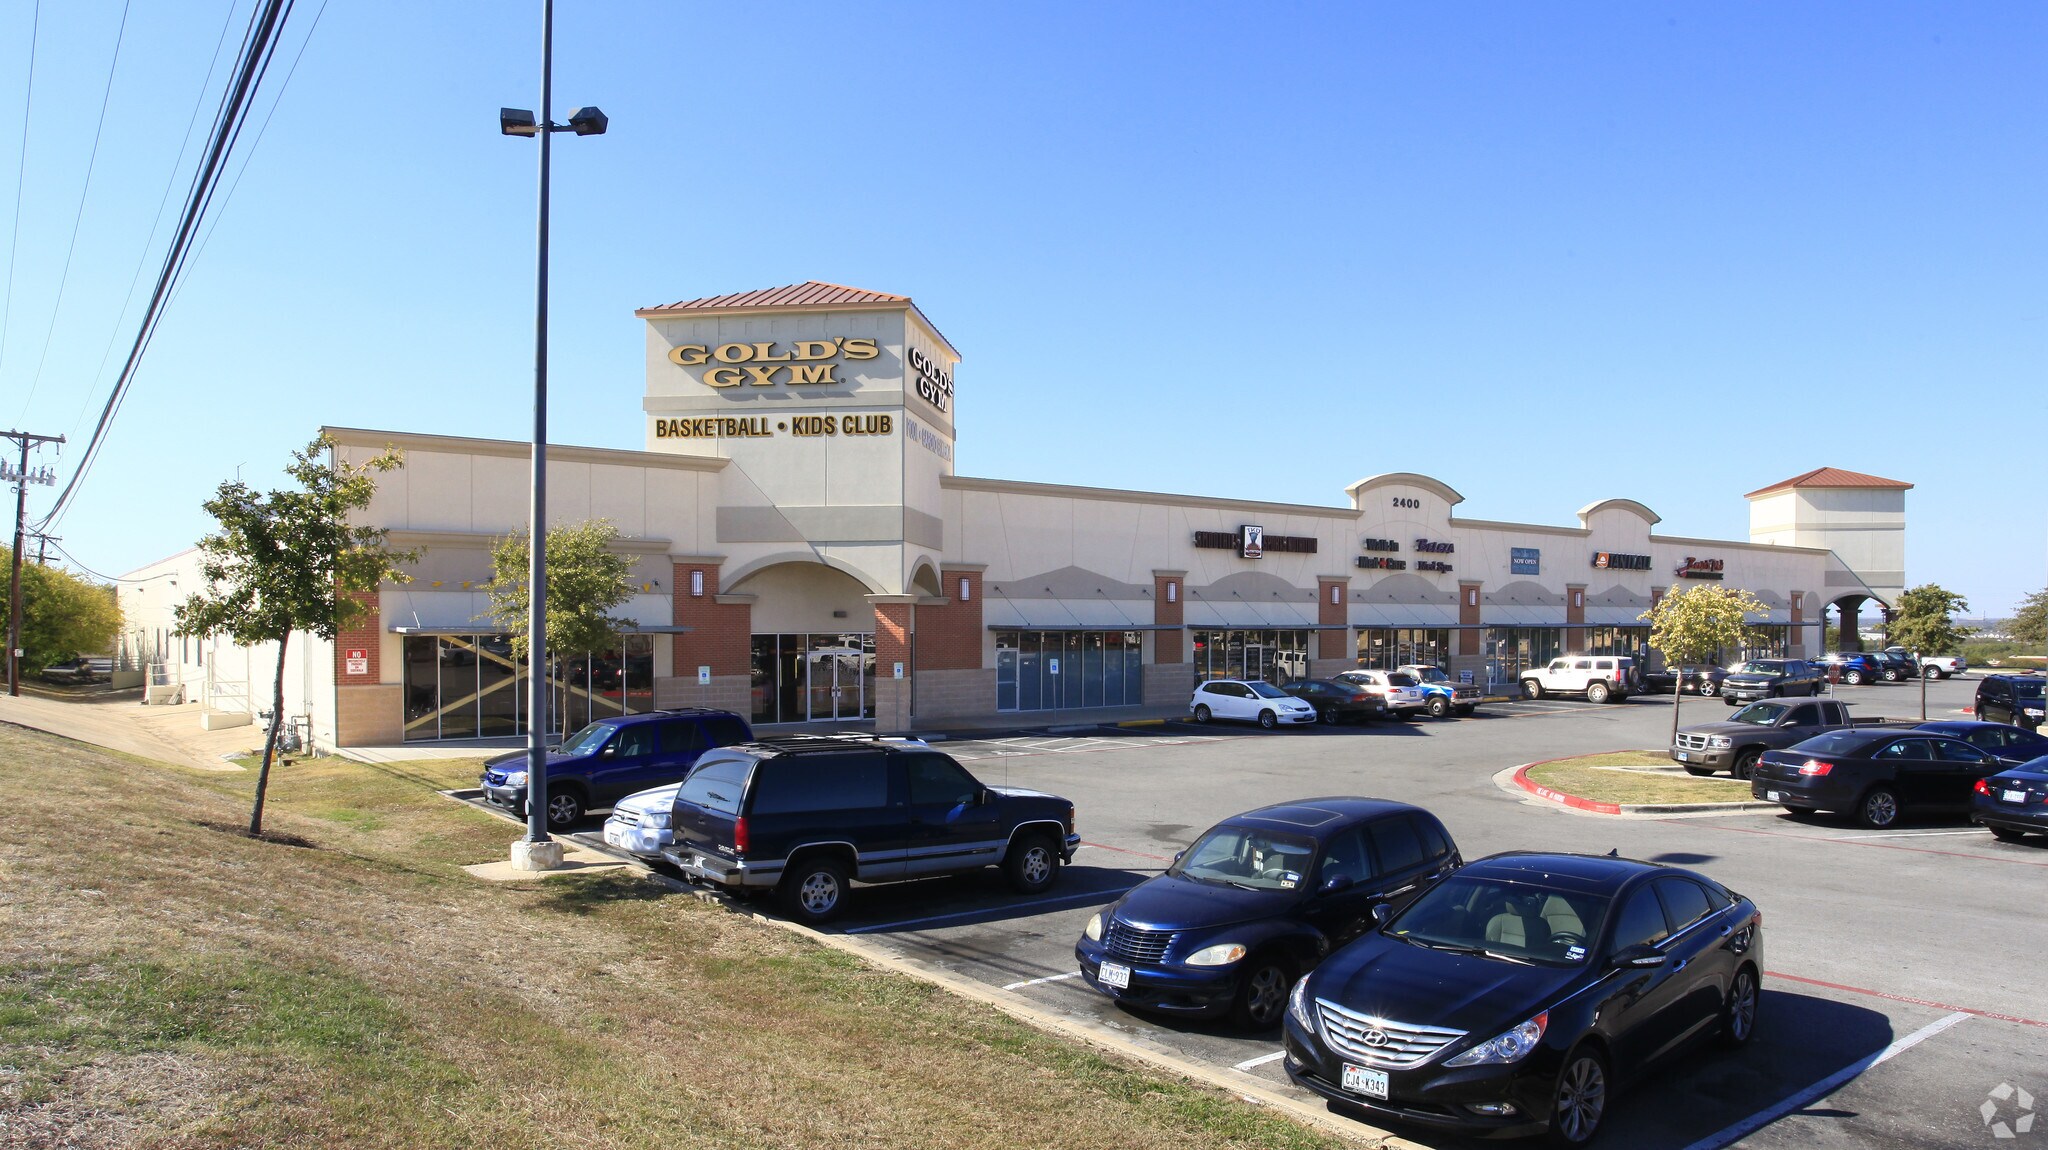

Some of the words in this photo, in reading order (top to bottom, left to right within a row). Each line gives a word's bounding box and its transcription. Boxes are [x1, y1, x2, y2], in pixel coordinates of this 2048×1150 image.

[668, 336, 880, 366] GOLD'S
[702, 363, 839, 388] GYM
[908, 347, 954, 398] GOLD'S
[916, 375, 948, 412] GYM
[656, 415, 773, 438] BASKETBALL
[791, 414, 837, 437] KIDS
[841, 414, 894, 436] CLUB
[1392, 497, 1420, 509] 2400
